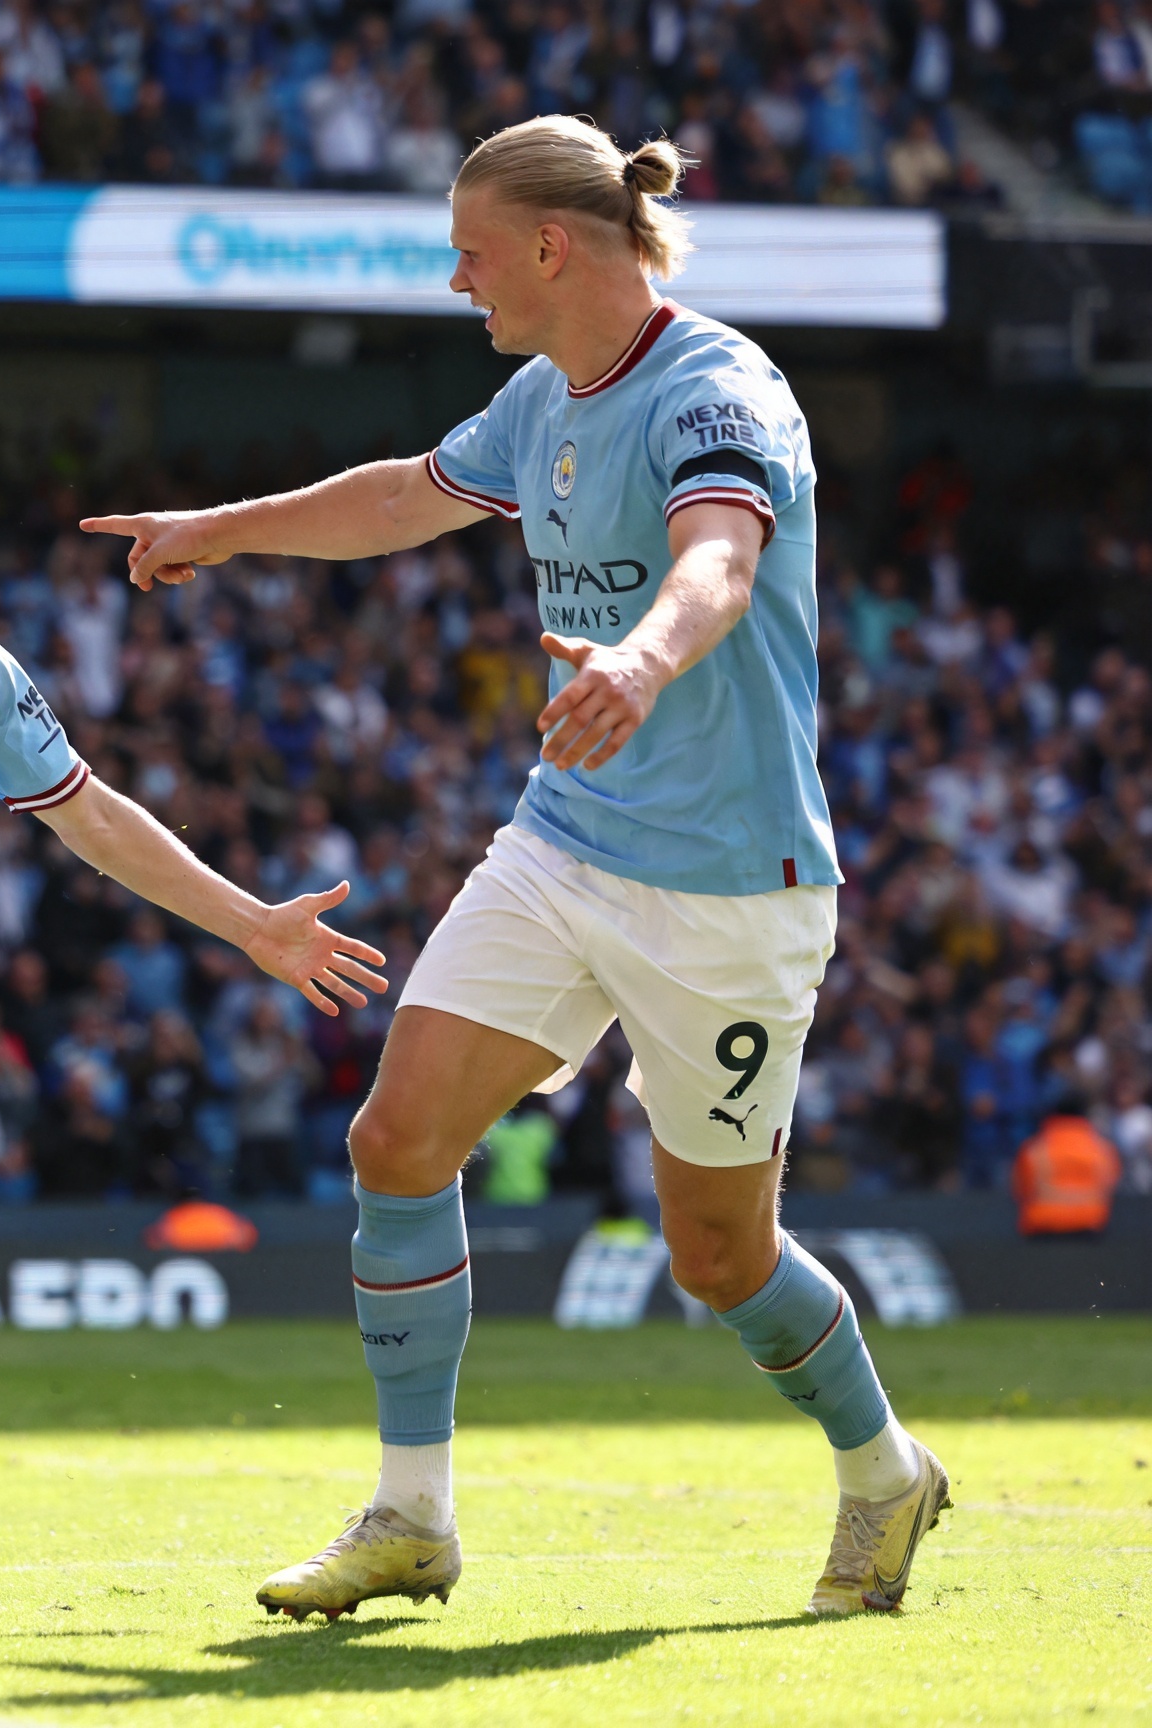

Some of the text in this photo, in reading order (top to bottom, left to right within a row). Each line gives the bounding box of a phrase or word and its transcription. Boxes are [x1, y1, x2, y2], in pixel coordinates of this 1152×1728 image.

[694, 422, 758, 447] TIRE
[530, 557, 648, 595] TIHAD
[715, 1021, 769, 1100] 9
